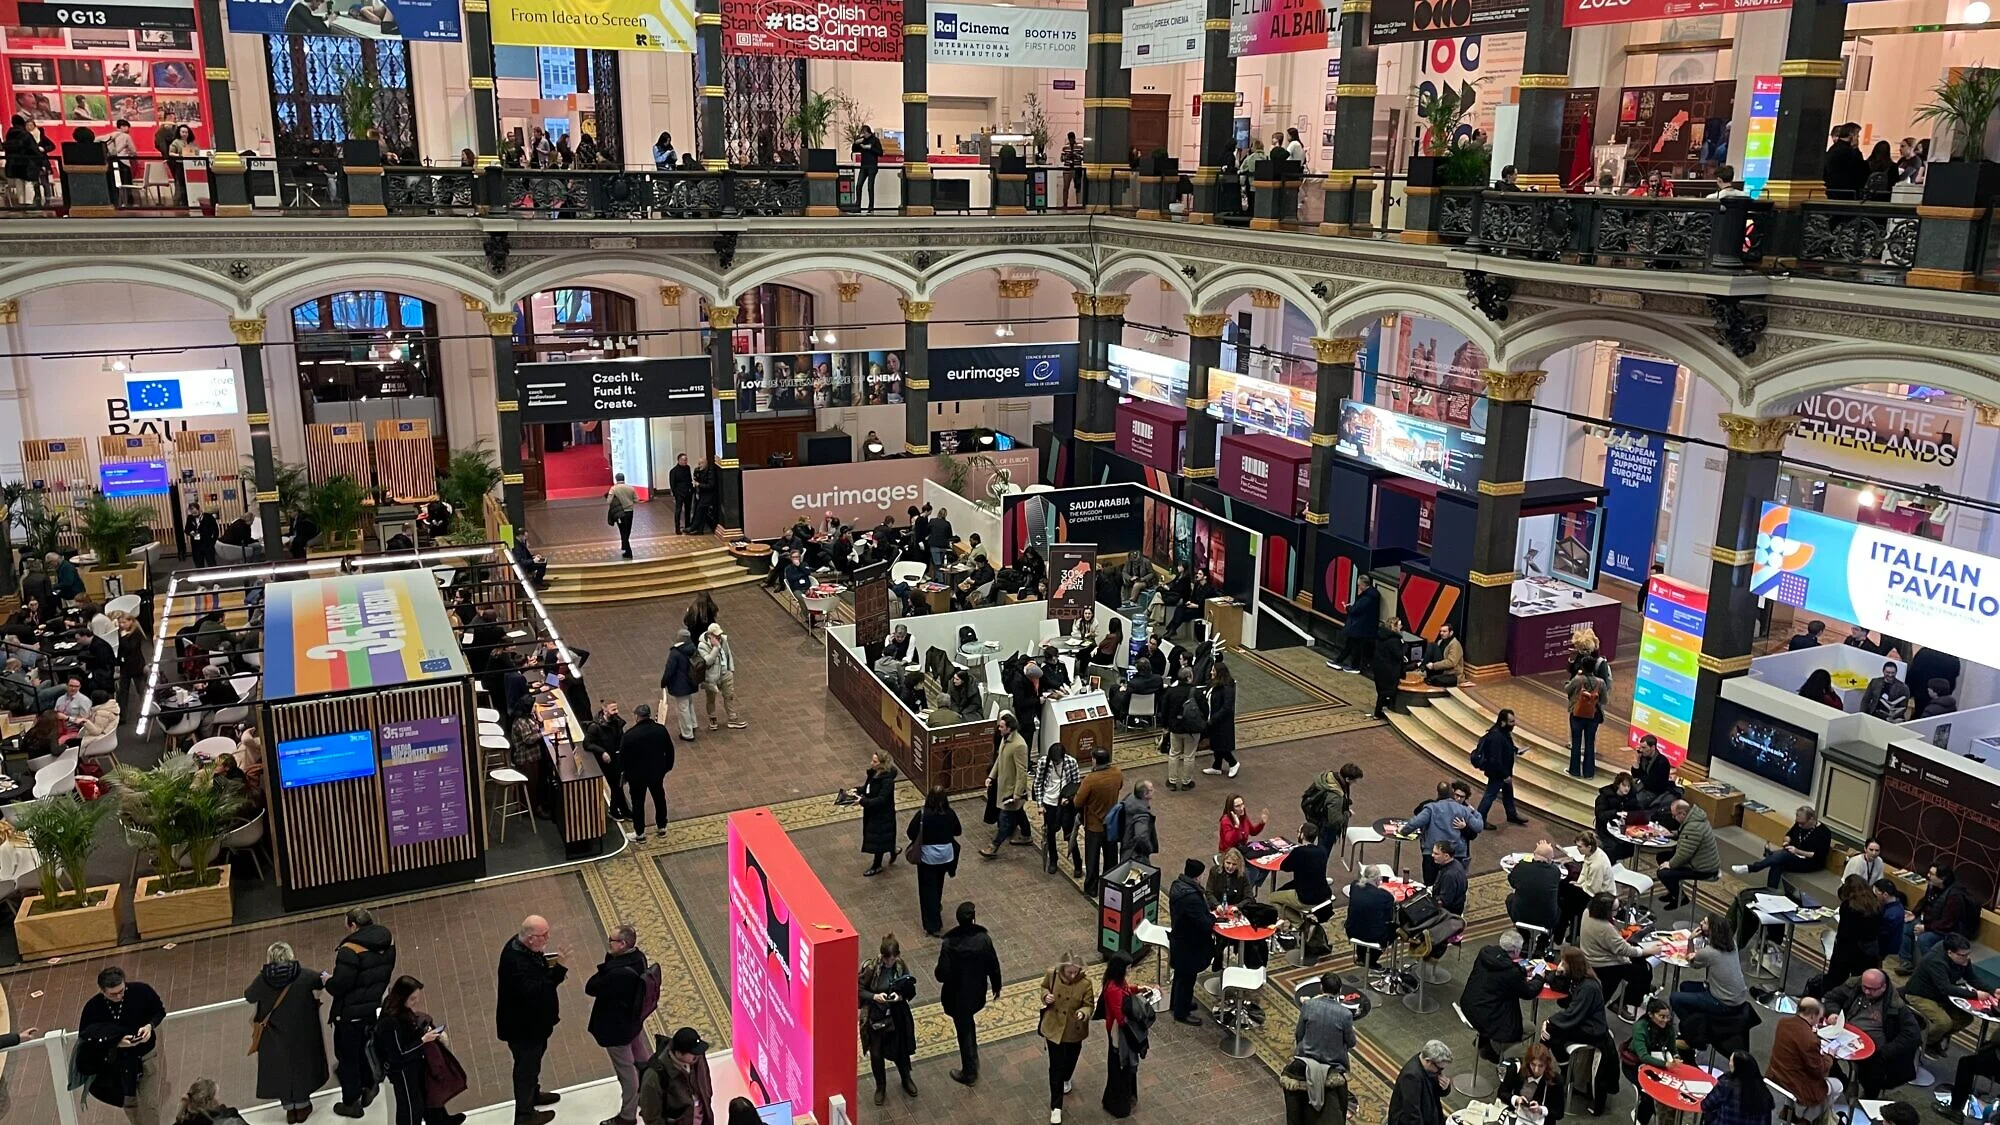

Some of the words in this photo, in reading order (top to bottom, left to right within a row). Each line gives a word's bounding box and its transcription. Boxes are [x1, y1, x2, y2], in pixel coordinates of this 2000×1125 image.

[71, 10, 106, 25] G13
[511, 8, 548, 22] From
[552, 9, 580, 24] Idea
[585, 12, 599, 25] to
[601, 13, 647, 28] Screen
[818, 4, 866, 21] Polish
[766, 13, 820, 32] #183
[825, 20, 887, 38] Cinema
[936, 20, 956, 33] Rai
[959, 22, 1009, 35] Cinema
[1132, 21, 1154, 31] Connecting
[1154, 18, 1170, 28] GREEK
[1170, 15, 1189, 26] CINEMA
[1025, 29, 1059, 40] BOOTH
[1062, 31, 1077, 40] 175
[1237, 33, 1258, 45] Gropius
[807, 35, 858, 52] Stand
[934, 41, 1009, 51] INTERNATIONAL
[1025, 42, 1047, 50] FIRST
[1049, 43, 1076, 52] FLOOR
[934, 49, 1009, 58] DISTRIBUTION
[592, 372, 629, 383] Czech
[631, 371, 644, 382] It.
[741, 380, 767, 390] LOVE
[867, 373, 901, 383] CINEMA
[947, 366, 1020, 383] eurimages
[593, 386, 623, 396] Fund
[624, 385, 637, 395] It.
[594, 399, 637, 410] Create.
[1797, 394, 1879, 427] NLOCK
[1885, 407, 1936, 436] THE
[1794, 418, 1957, 467] ETHERLANDS
[1610, 449, 1658, 467] PARLIAMENT
[1615, 443, 1656, 459] EOPEAN
[1613, 459, 1652, 475] SUPPORTS
[1611, 467, 1652, 484] EUROPEAN
[1621, 477, 1640, 489] FILM
[791, 483, 919, 510] eurimages
[1069, 500, 1097, 511] SAUDI
[1098, 497, 1131, 508] ARABIA
[1076, 515, 1102, 523] CINEMATIC
[1103, 512, 1130, 520] TREASURES
[1617, 553, 1630, 567] LUX
[1871, 541, 1981, 588] ITALIAN
[1061, 569, 1084, 579] 30%
[362, 588, 401, 614] MEDIA
[1888, 569, 2000, 617] PAVILIO
[325, 603, 362, 629] YEARS
[306, 622, 407, 660] 35
[383, 726, 399, 739] 35
[428, 744, 449, 754] FILMS
[1925, 772, 1950, 785] MOROCCO
